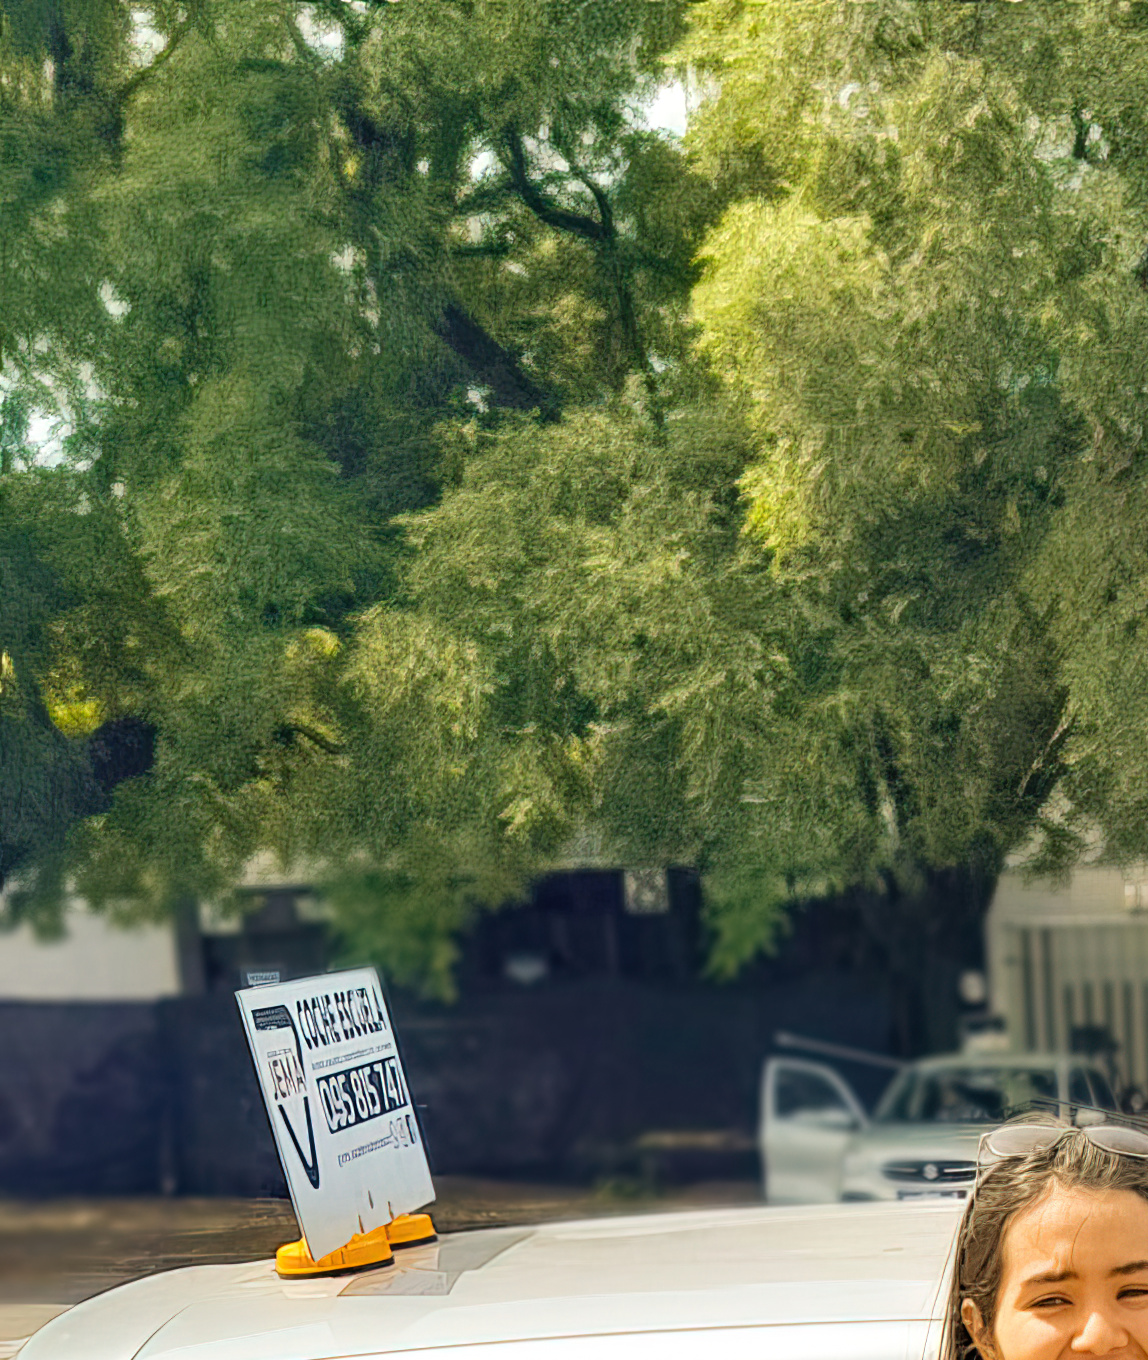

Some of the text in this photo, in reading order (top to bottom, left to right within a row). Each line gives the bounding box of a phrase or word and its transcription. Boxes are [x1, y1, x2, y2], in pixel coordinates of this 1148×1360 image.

[268, 1053, 307, 1100] JEMA
[319, 1059, 405, 1131] 095 815 747
